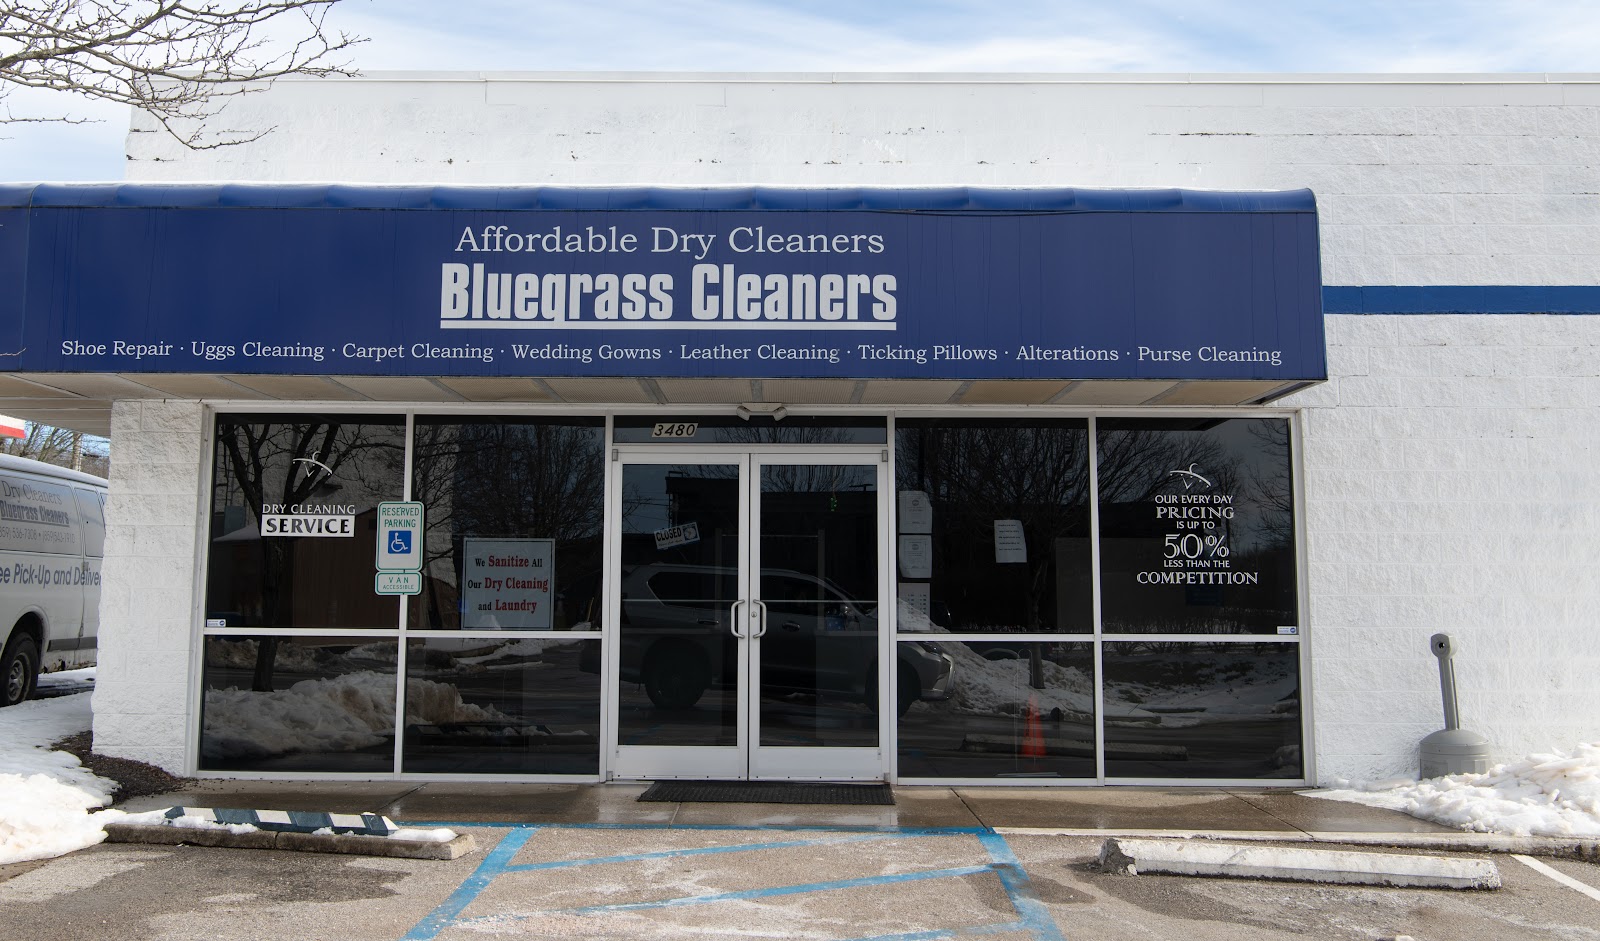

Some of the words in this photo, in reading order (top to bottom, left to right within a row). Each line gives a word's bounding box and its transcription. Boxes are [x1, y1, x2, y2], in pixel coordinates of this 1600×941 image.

[454, 225, 638, 253] Affordable
[650, 226, 717, 261] Dry
[728, 225, 885, 254] Cleaners
[440, 262, 674, 322] Bluegrass
[691, 263, 897, 321] Cleaners
[61, 340, 107, 356] Shoe
[112, 340, 174, 360] Repair
[191, 341, 236, 361] Uggs
[242, 341, 325, 362] Cleaning
[342, 342, 405, 362] Carpet
[411, 342, 494, 363] Cleaning
[511, 343, 593, 364] Wedding
[598, 344, 662, 360] Gowns
[680, 344, 752, 360] Leather
[757, 343, 840, 364] Cleaning
[857, 344, 928, 365] Ticking
[932, 344, 998, 361] Pillows
[1015, 344, 1119, 361] Alterations
[1137, 346, 1192, 362] Purse
[1197, 346, 1282, 366] Cleaning
[654, 423, 696, 437] 3480
[1, 480, 20, 503] Dry
[22, 484, 62, 505] Cleaners
[1154, 494, 1179, 504] OUR
[1181, 494, 1211, 504] EVERY
[1213, 495, 1233, 504] DAY
[39, 505, 69, 525] Cleaners
[262, 503, 287, 514] DRY
[290, 503, 356, 515] CLEANING
[381, 507, 419, 517] RESERVED
[1156, 506, 1235, 519] PRICING
[266, 517, 350, 534] SERVICE
[384, 518, 416, 528] PARKING
[1176, 520, 1185, 529] IS
[1187, 521, 1200, 529] UP
[1202, 521, 1215, 529] TO
[656, 527, 682, 542] CLOSED
[1163, 533, 1230, 559] 50%
[475, 558, 485, 567] We
[488, 555, 529, 568] Sanitize
[531, 558, 542, 568] All
[1163, 559, 1184, 568] LESS
[1185, 559, 1211, 568] THAN
[1212, 560, 1231, 568] THE
[13, 563, 51, 589] Pick-Up
[53, 567, 72, 586] and
[388, 576, 409, 584] VAN
[1136, 571, 1258, 585] COMPETITION
[467, 580, 482, 589] Our
[484, 577, 503, 592] Dry
[505, 577, 549, 593] Cleaning
[478, 602, 492, 611] and
[495, 599, 537, 614] Laundry
